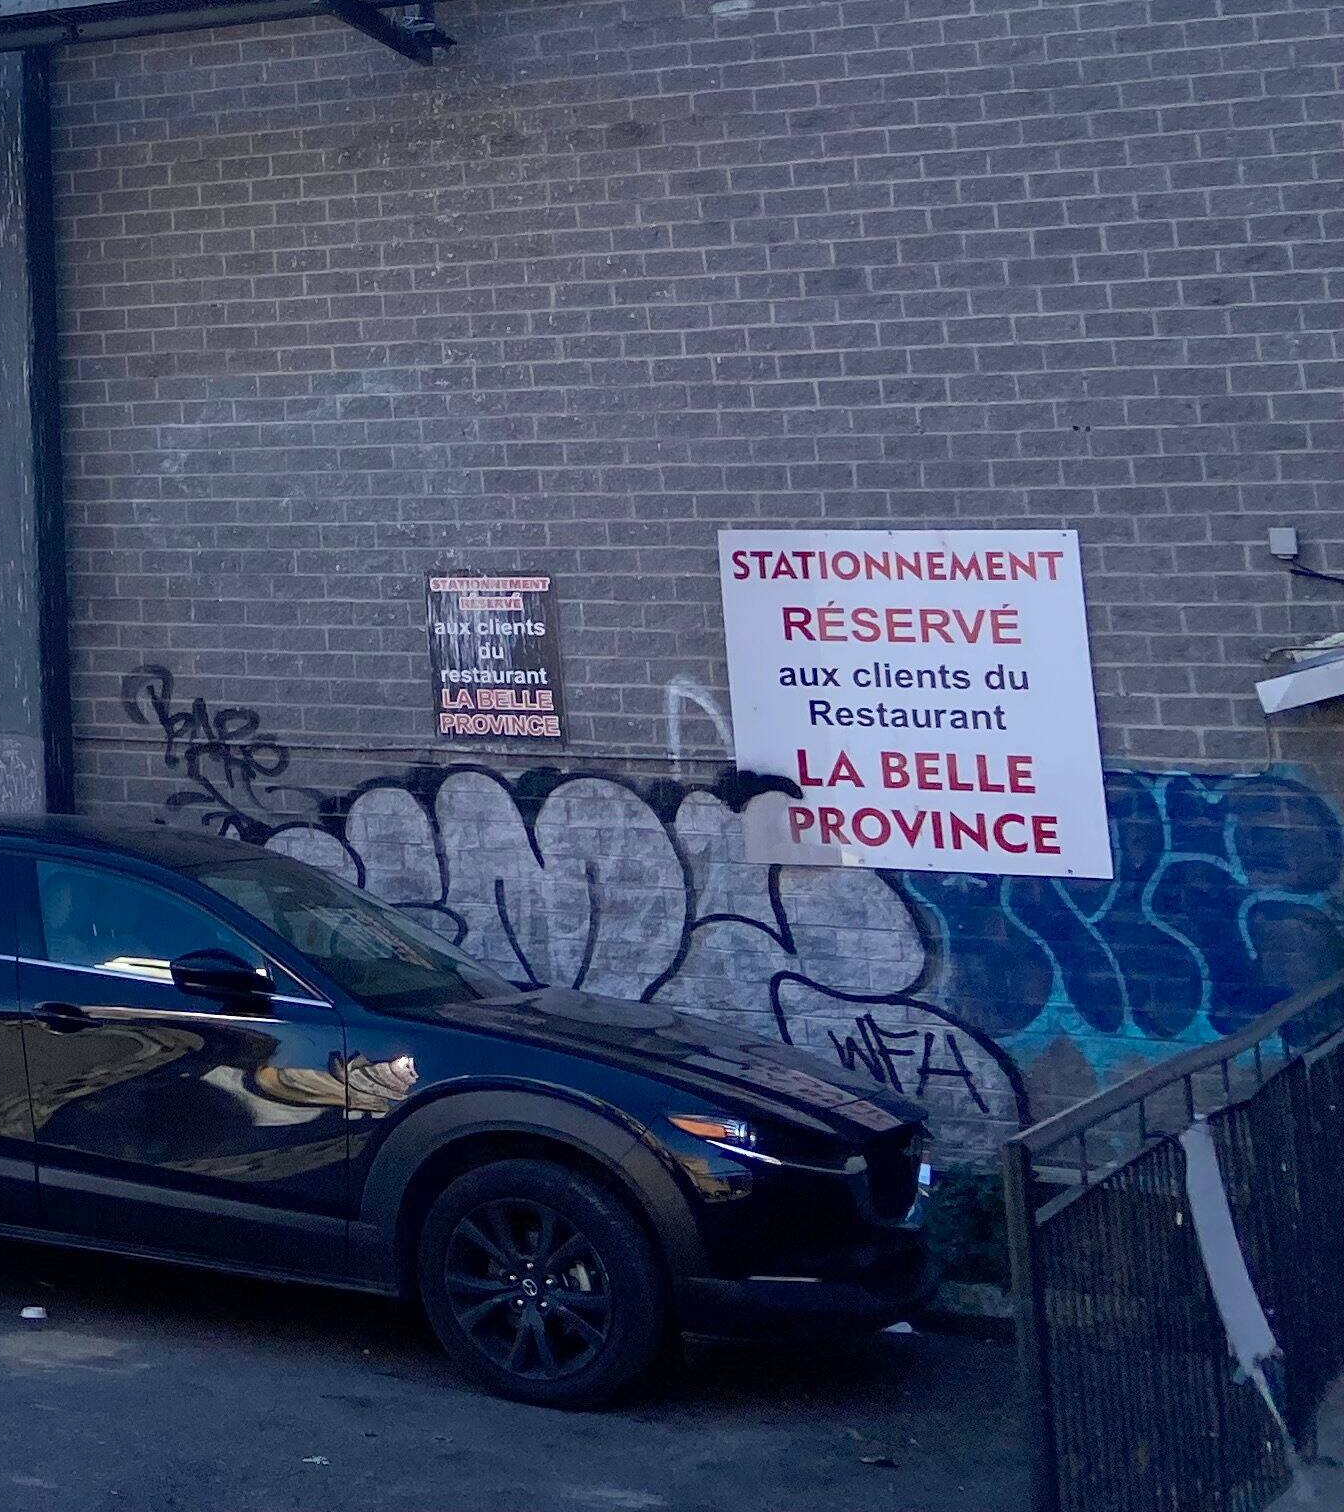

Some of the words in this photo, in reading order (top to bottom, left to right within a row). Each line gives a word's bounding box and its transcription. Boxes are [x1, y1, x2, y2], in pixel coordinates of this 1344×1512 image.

[731, 550, 1064, 582] STATIONNEMENT
[430, 576, 550, 592] STATIONNEMENT
[434, 621, 471, 635] aux
[477, 619, 546, 636] clients
[781, 600, 1022, 645] RÉSERVÉ
[478, 642, 505, 659] du
[440, 667, 549, 685] restaurant
[778, 666, 840, 688] aux
[852, 661, 971, 690] clients
[984, 663, 1030, 691] du
[441, 688, 474, 709] LA
[476, 689, 555, 711] BELLE
[439, 713, 561, 737] PROVINCE
[808, 699, 1008, 731] Restaurant
[796, 749, 866, 789] LA
[880, 751, 1037, 794] BELLE
[788, 806, 1062, 856] PROVINCE
